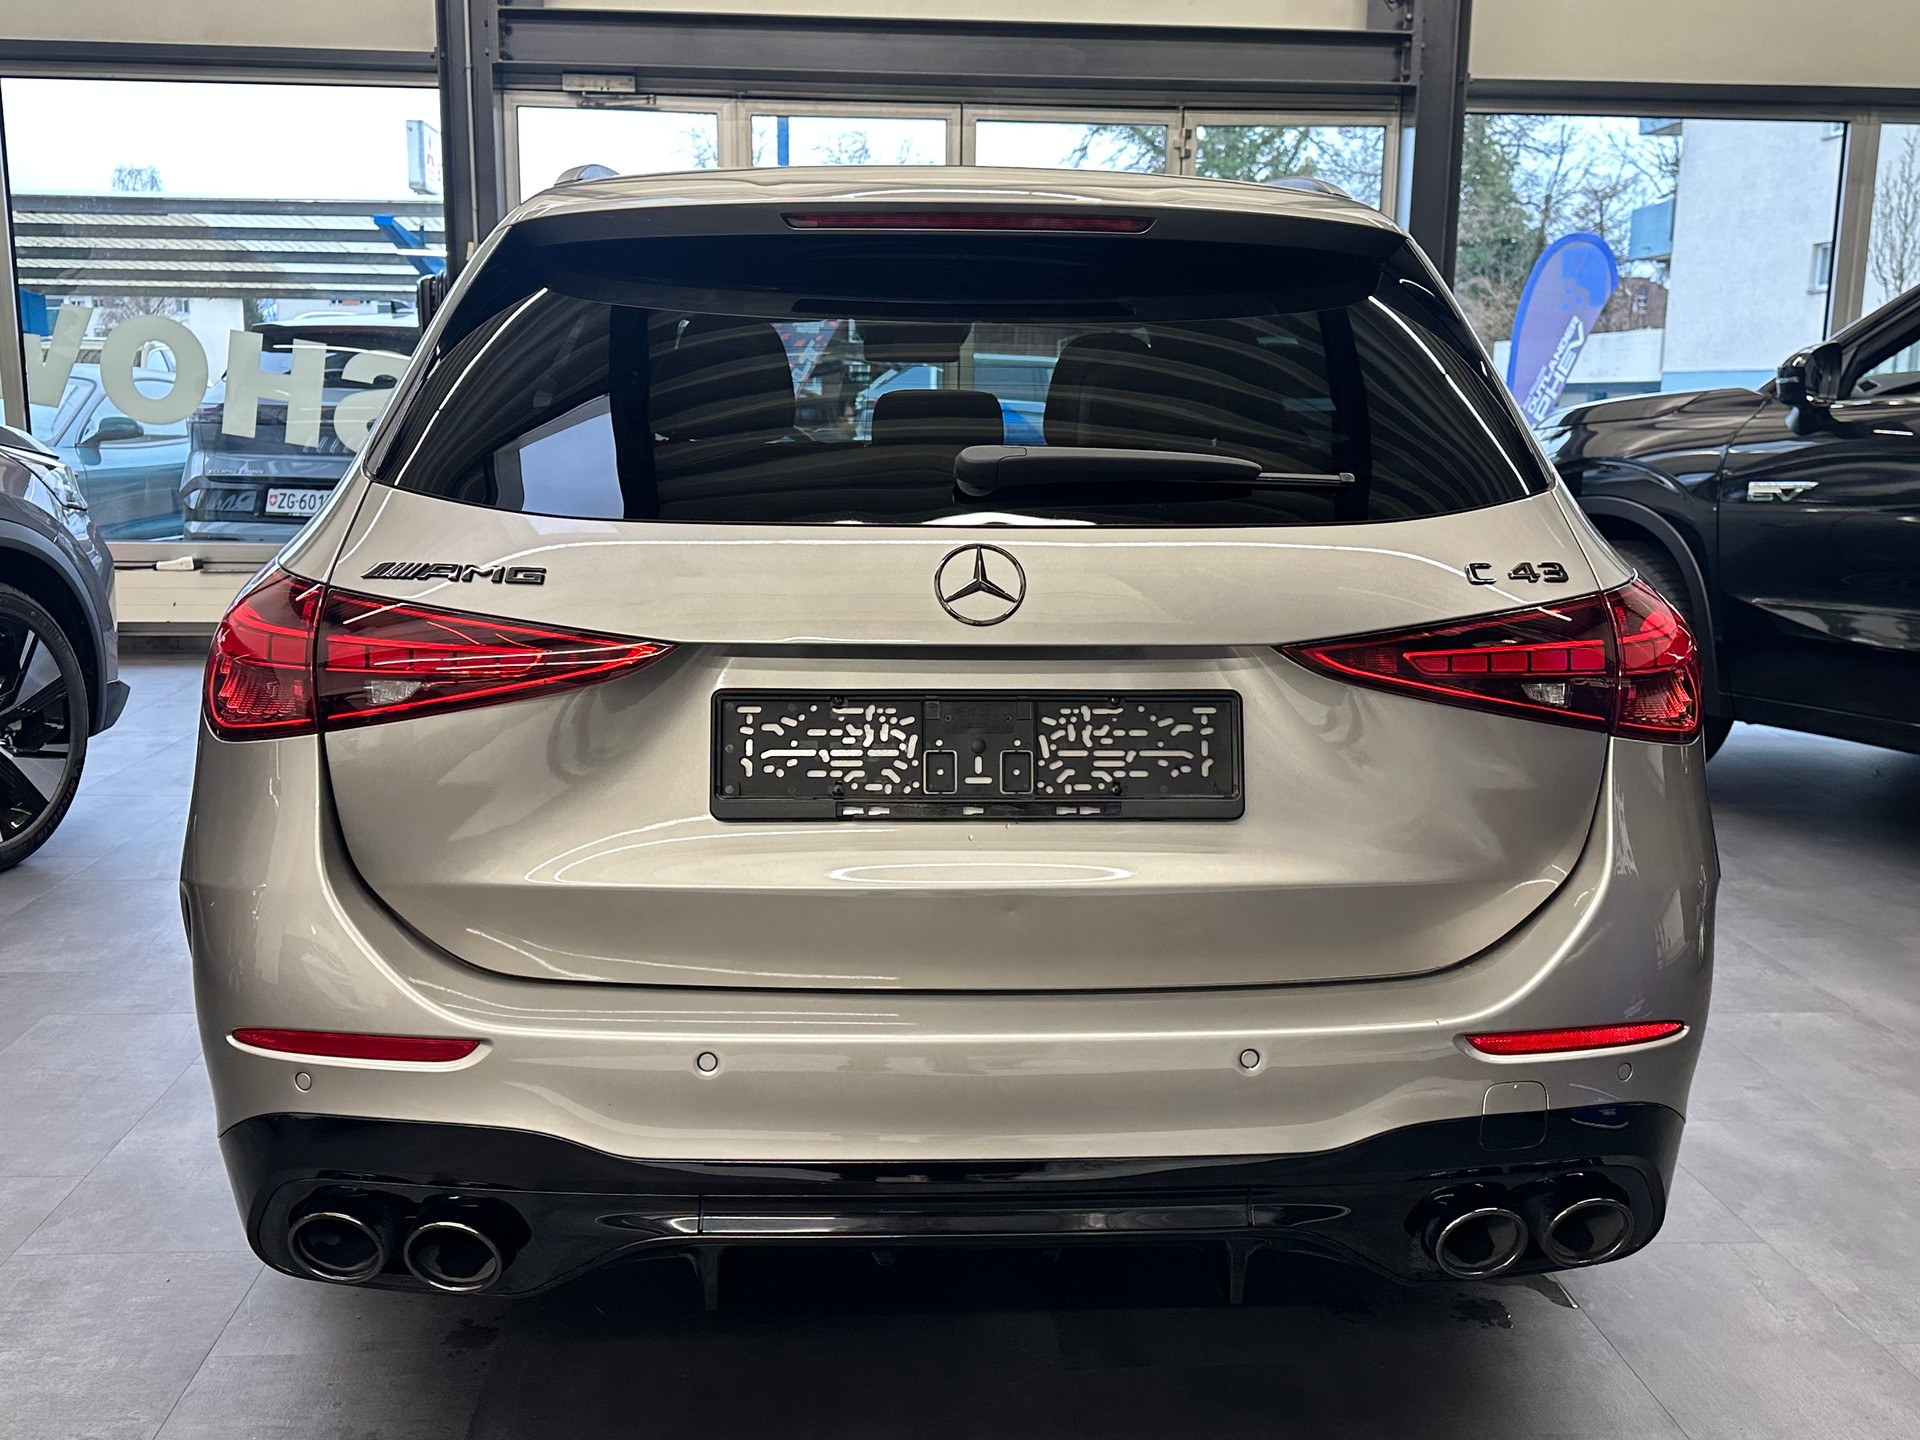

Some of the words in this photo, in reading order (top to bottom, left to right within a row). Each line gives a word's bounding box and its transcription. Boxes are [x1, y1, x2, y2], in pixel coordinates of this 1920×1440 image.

[1527, 315, 1580, 415] OUTLANDER
[1532, 320, 1585, 422] PHEV
[1747, 484, 1804, 501] EV
[416, 563, 547, 585] AMG
[1465, 562, 1497, 585] C
[1507, 562, 1569, 583] 43
